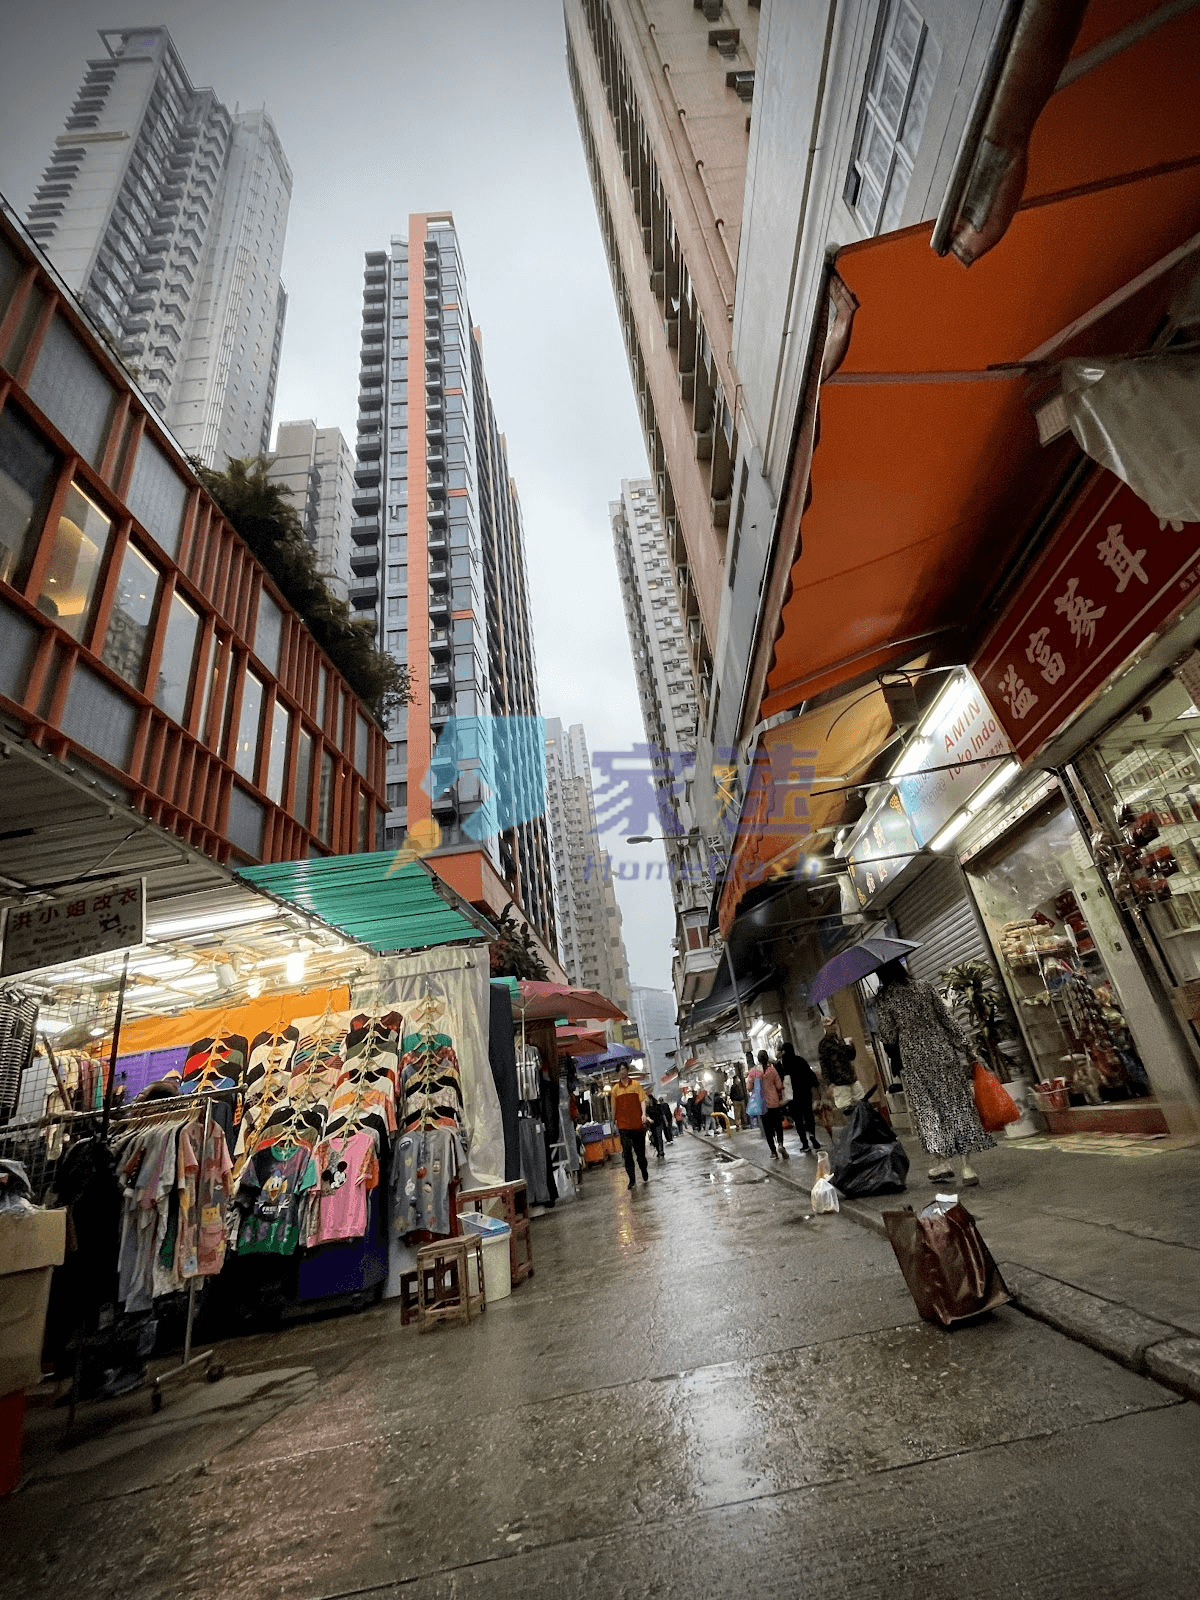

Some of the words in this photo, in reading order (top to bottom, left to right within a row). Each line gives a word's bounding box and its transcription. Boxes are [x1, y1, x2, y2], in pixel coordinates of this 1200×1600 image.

[998, 518, 1184, 719] 溢富參茸
[944, 697, 981, 752] AMIN
[971, 718, 996, 753] Indo
[13, 887, 138, 930] 洪小姐改衣
